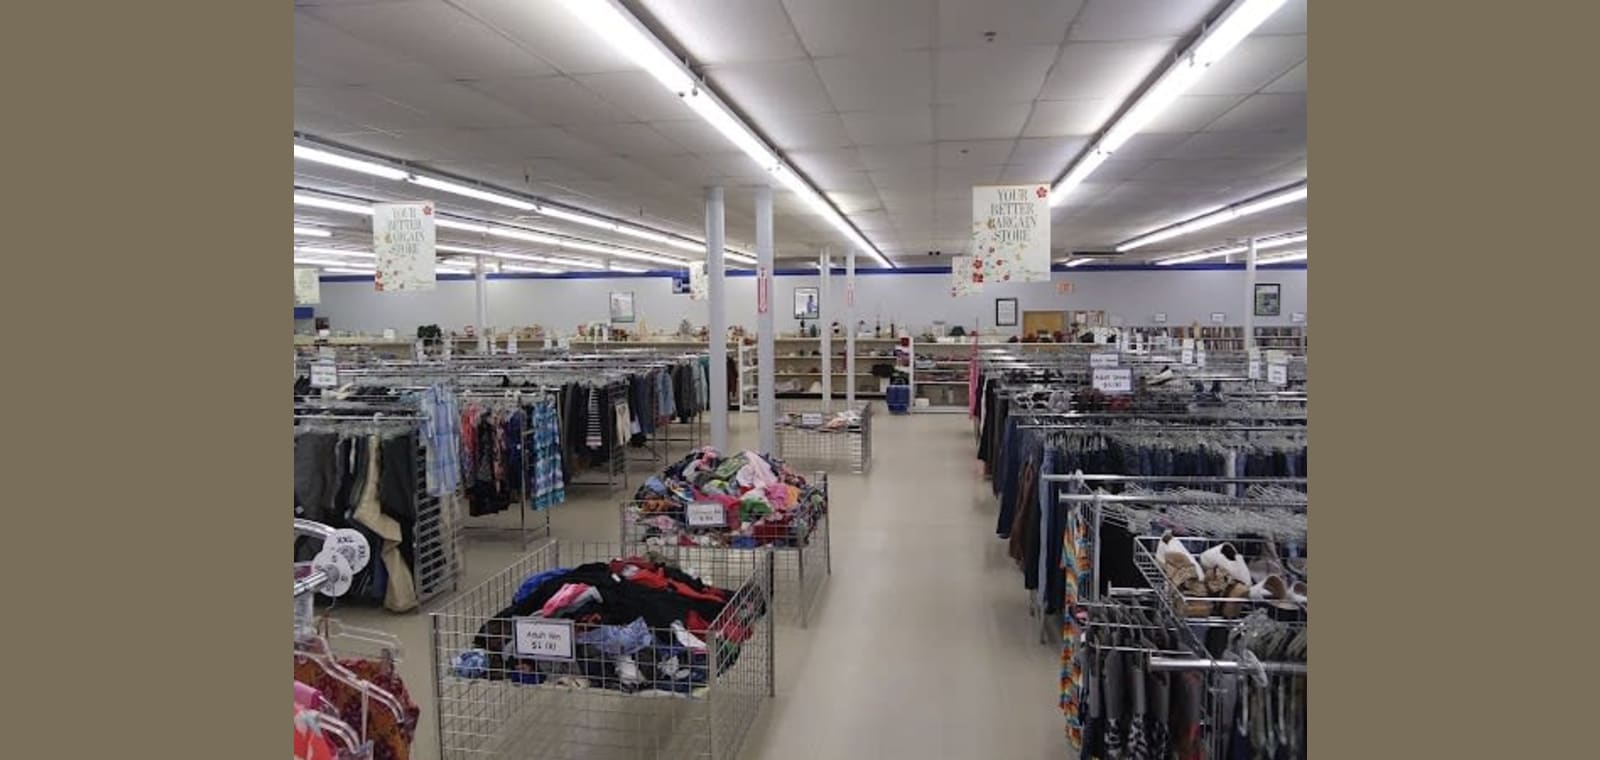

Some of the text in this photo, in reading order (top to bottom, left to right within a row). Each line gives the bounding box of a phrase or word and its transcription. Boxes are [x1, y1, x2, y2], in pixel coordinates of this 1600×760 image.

[998, 189, 1028, 201] YOUR
[990, 202, 1035, 215] BETTER
[994, 229, 1027, 242] STORE
[337, 536, 355, 544] XXL
